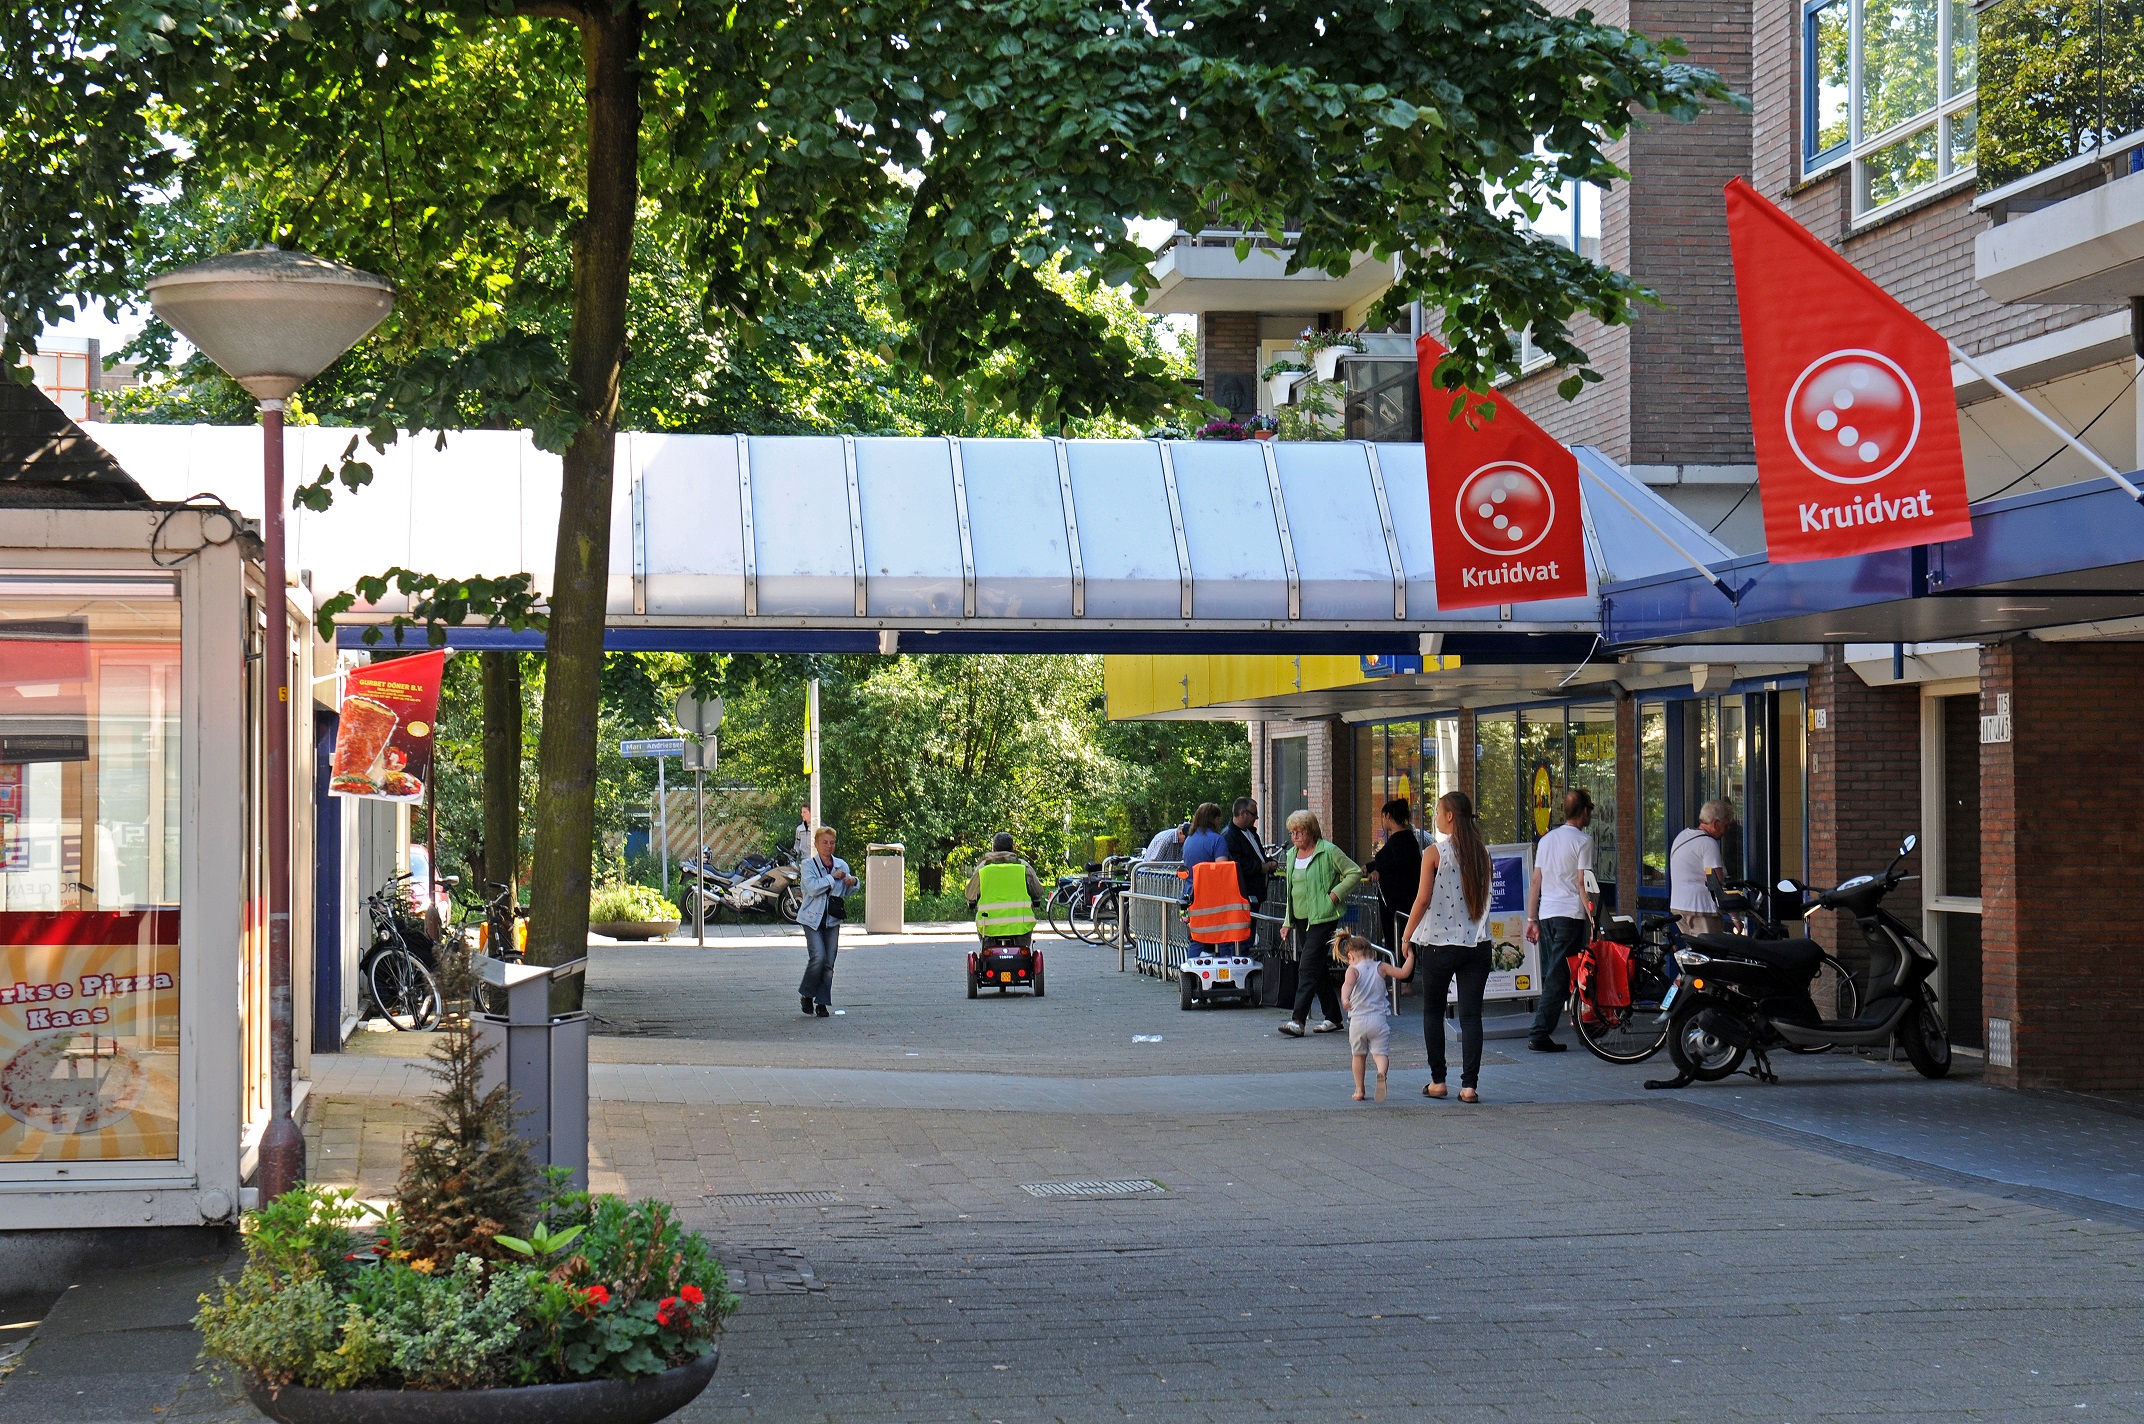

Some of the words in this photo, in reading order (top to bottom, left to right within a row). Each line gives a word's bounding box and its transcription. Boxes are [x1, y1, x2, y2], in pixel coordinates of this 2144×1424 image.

[1798, 489, 1934, 533] Kruidvat
[1462, 560, 1560, 588] Kruidvat
[359, 679, 387, 688] GURBET
[387, 681, 410, 691] DÖNER
[81, 973, 173, 997] Pizza
[27, 1008, 109, 1030] Kaas
